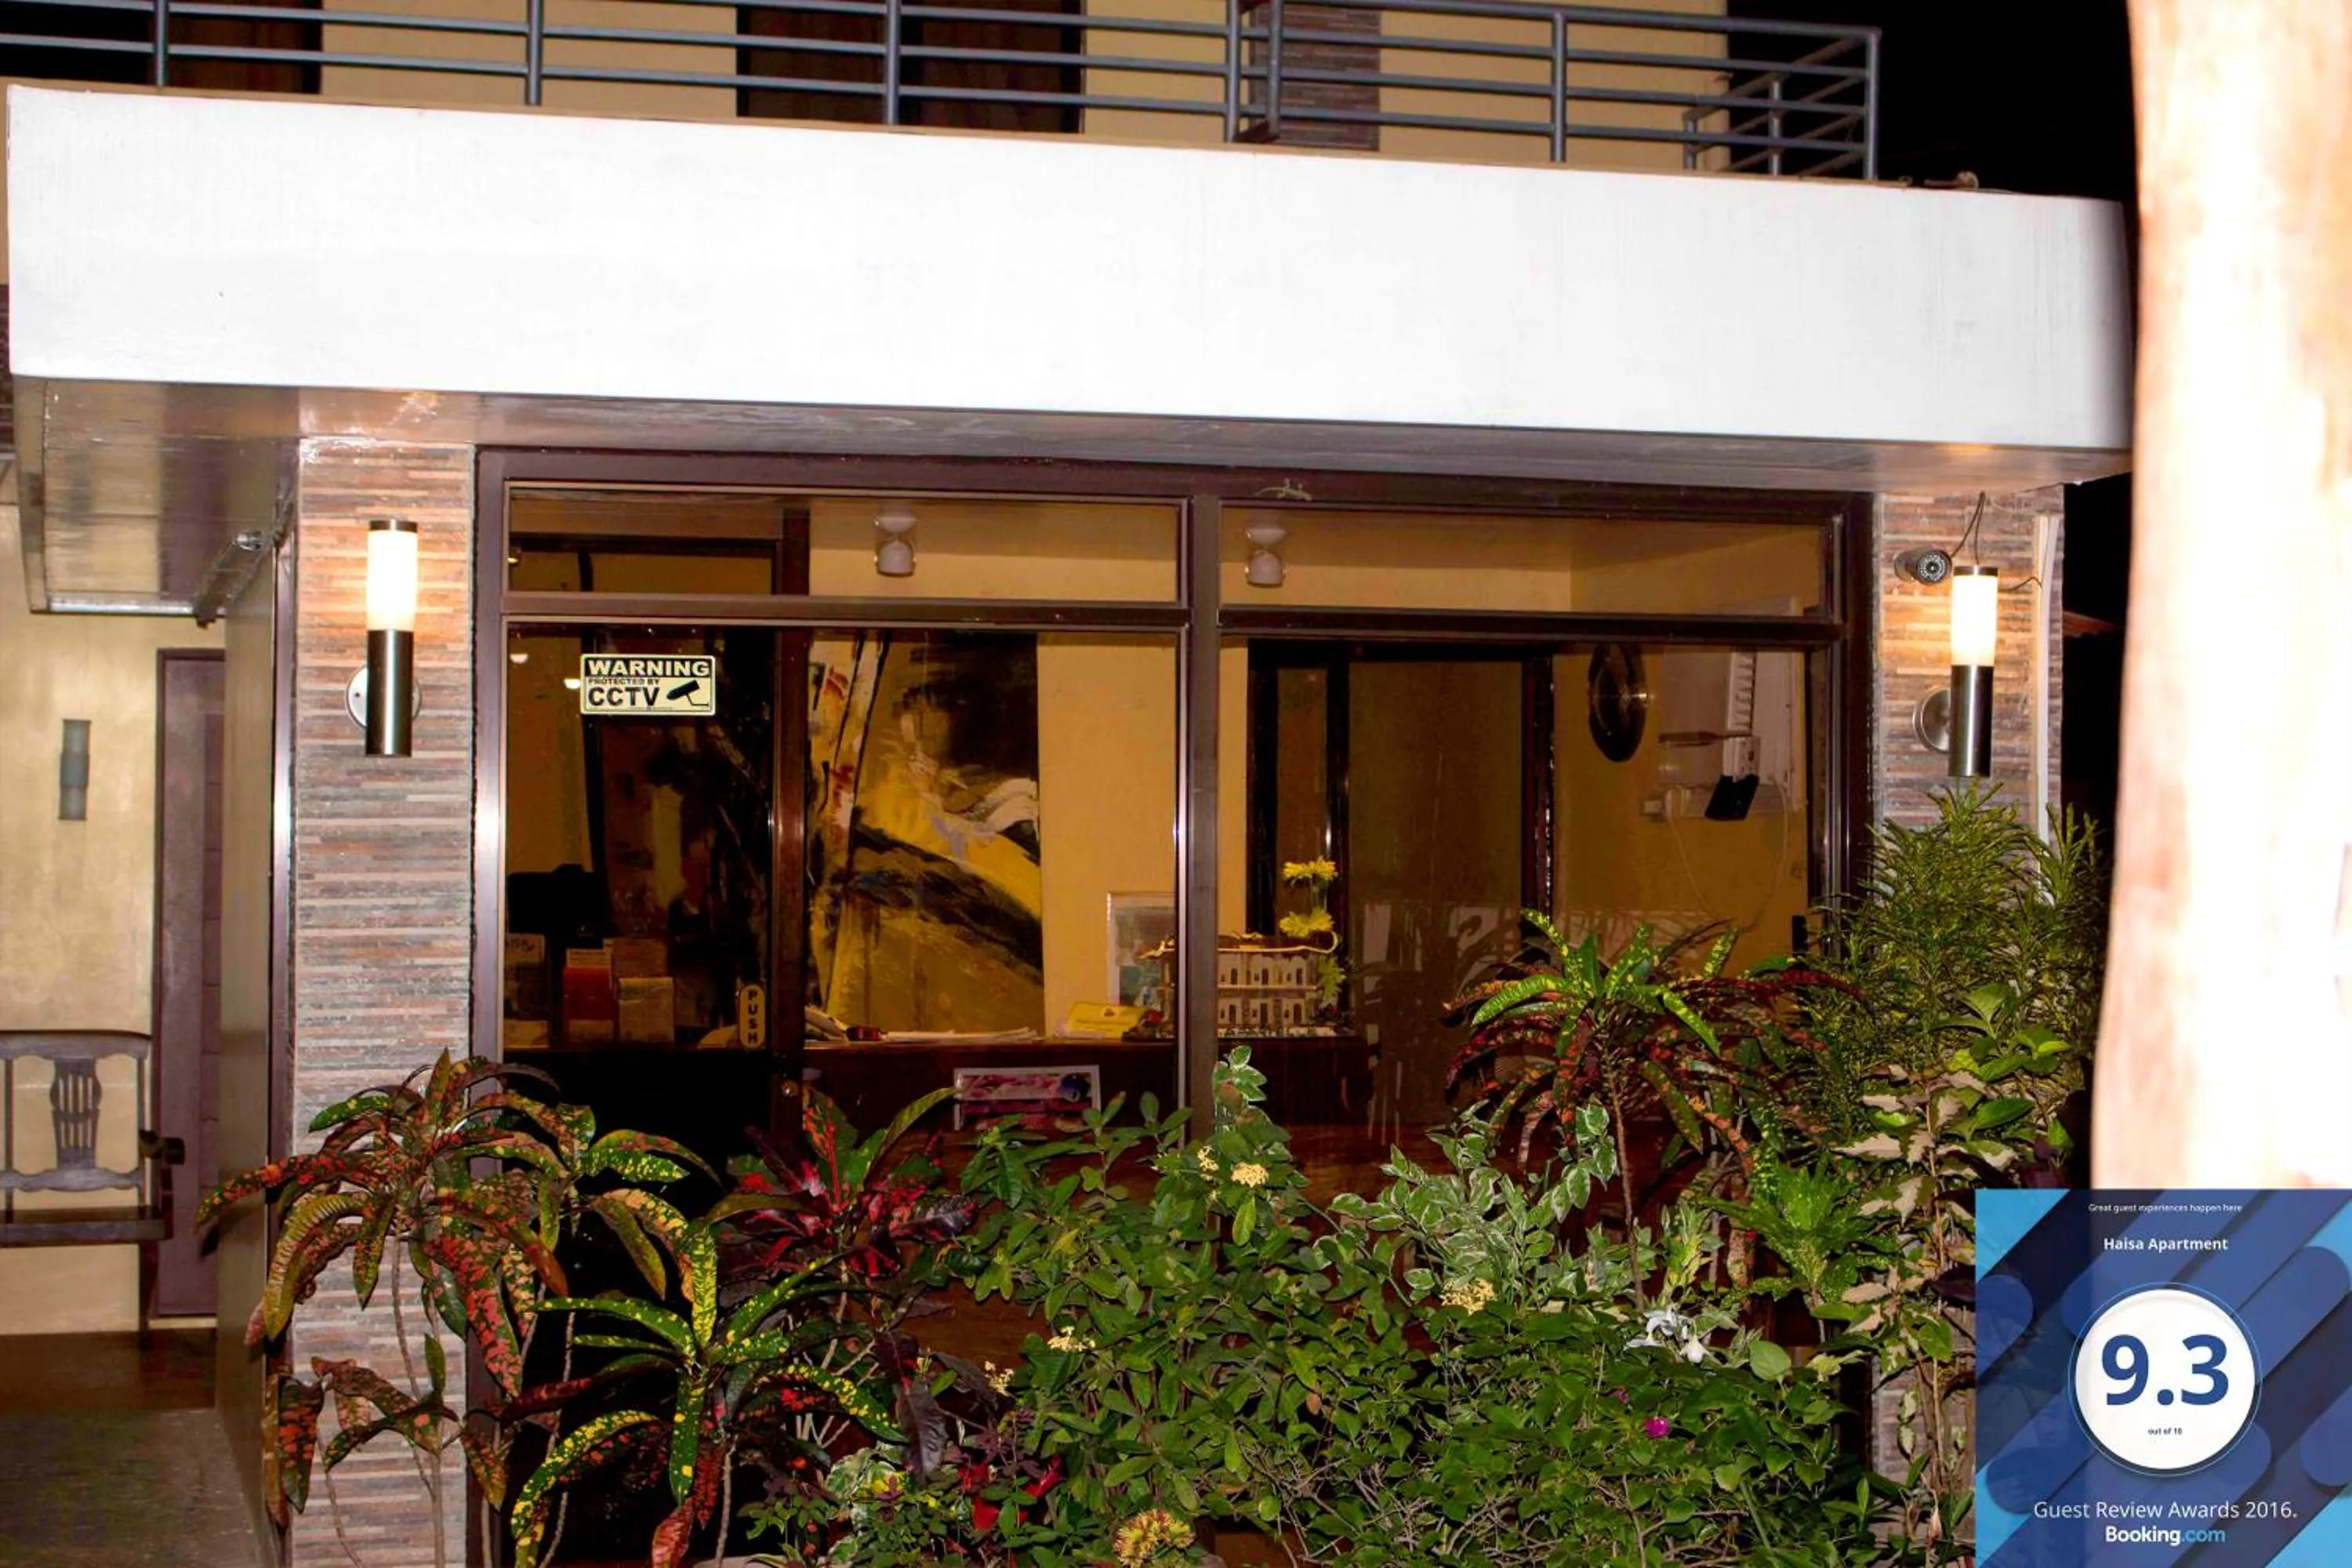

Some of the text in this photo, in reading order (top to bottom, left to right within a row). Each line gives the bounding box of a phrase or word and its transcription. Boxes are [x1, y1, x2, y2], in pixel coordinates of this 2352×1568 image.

[587, 659, 710, 677] WARNING
[588, 687, 660, 706] CCTV
[747, 989, 759, 1045] PUSH
